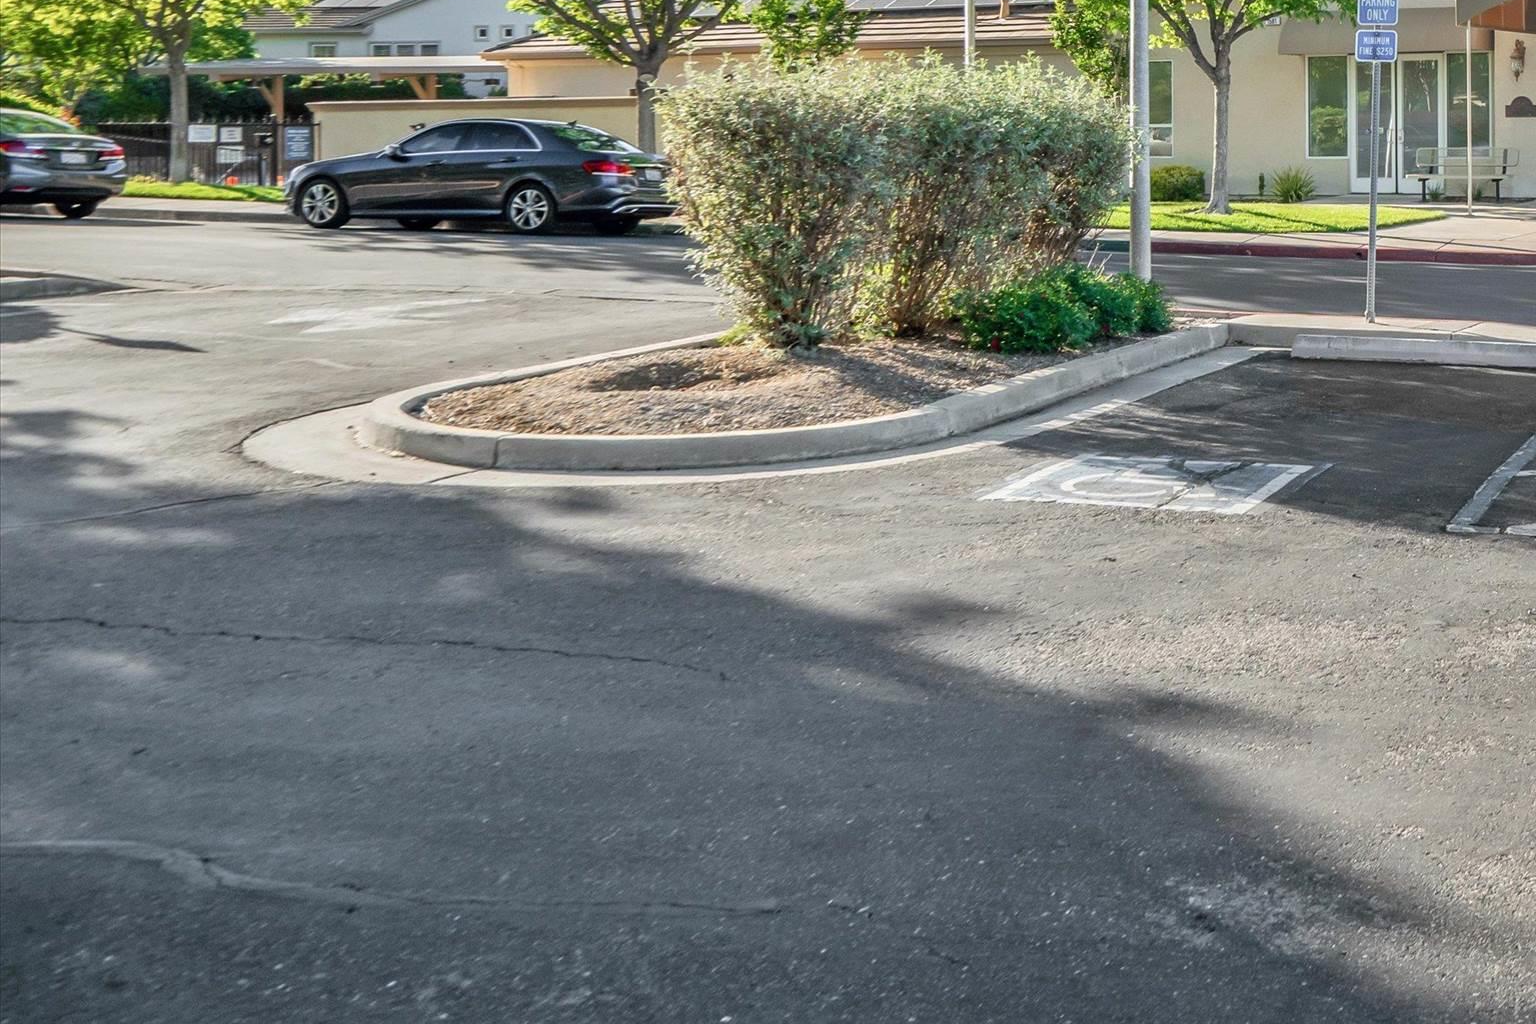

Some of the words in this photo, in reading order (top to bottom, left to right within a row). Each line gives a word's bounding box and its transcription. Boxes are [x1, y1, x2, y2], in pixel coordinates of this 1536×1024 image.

[1366, 9, 1389, 21] ONLY
[1363, 36, 1390, 45] MINIMUM
[1359, 47, 1373, 56] FINE
[1376, 47, 1394, 56] $250
